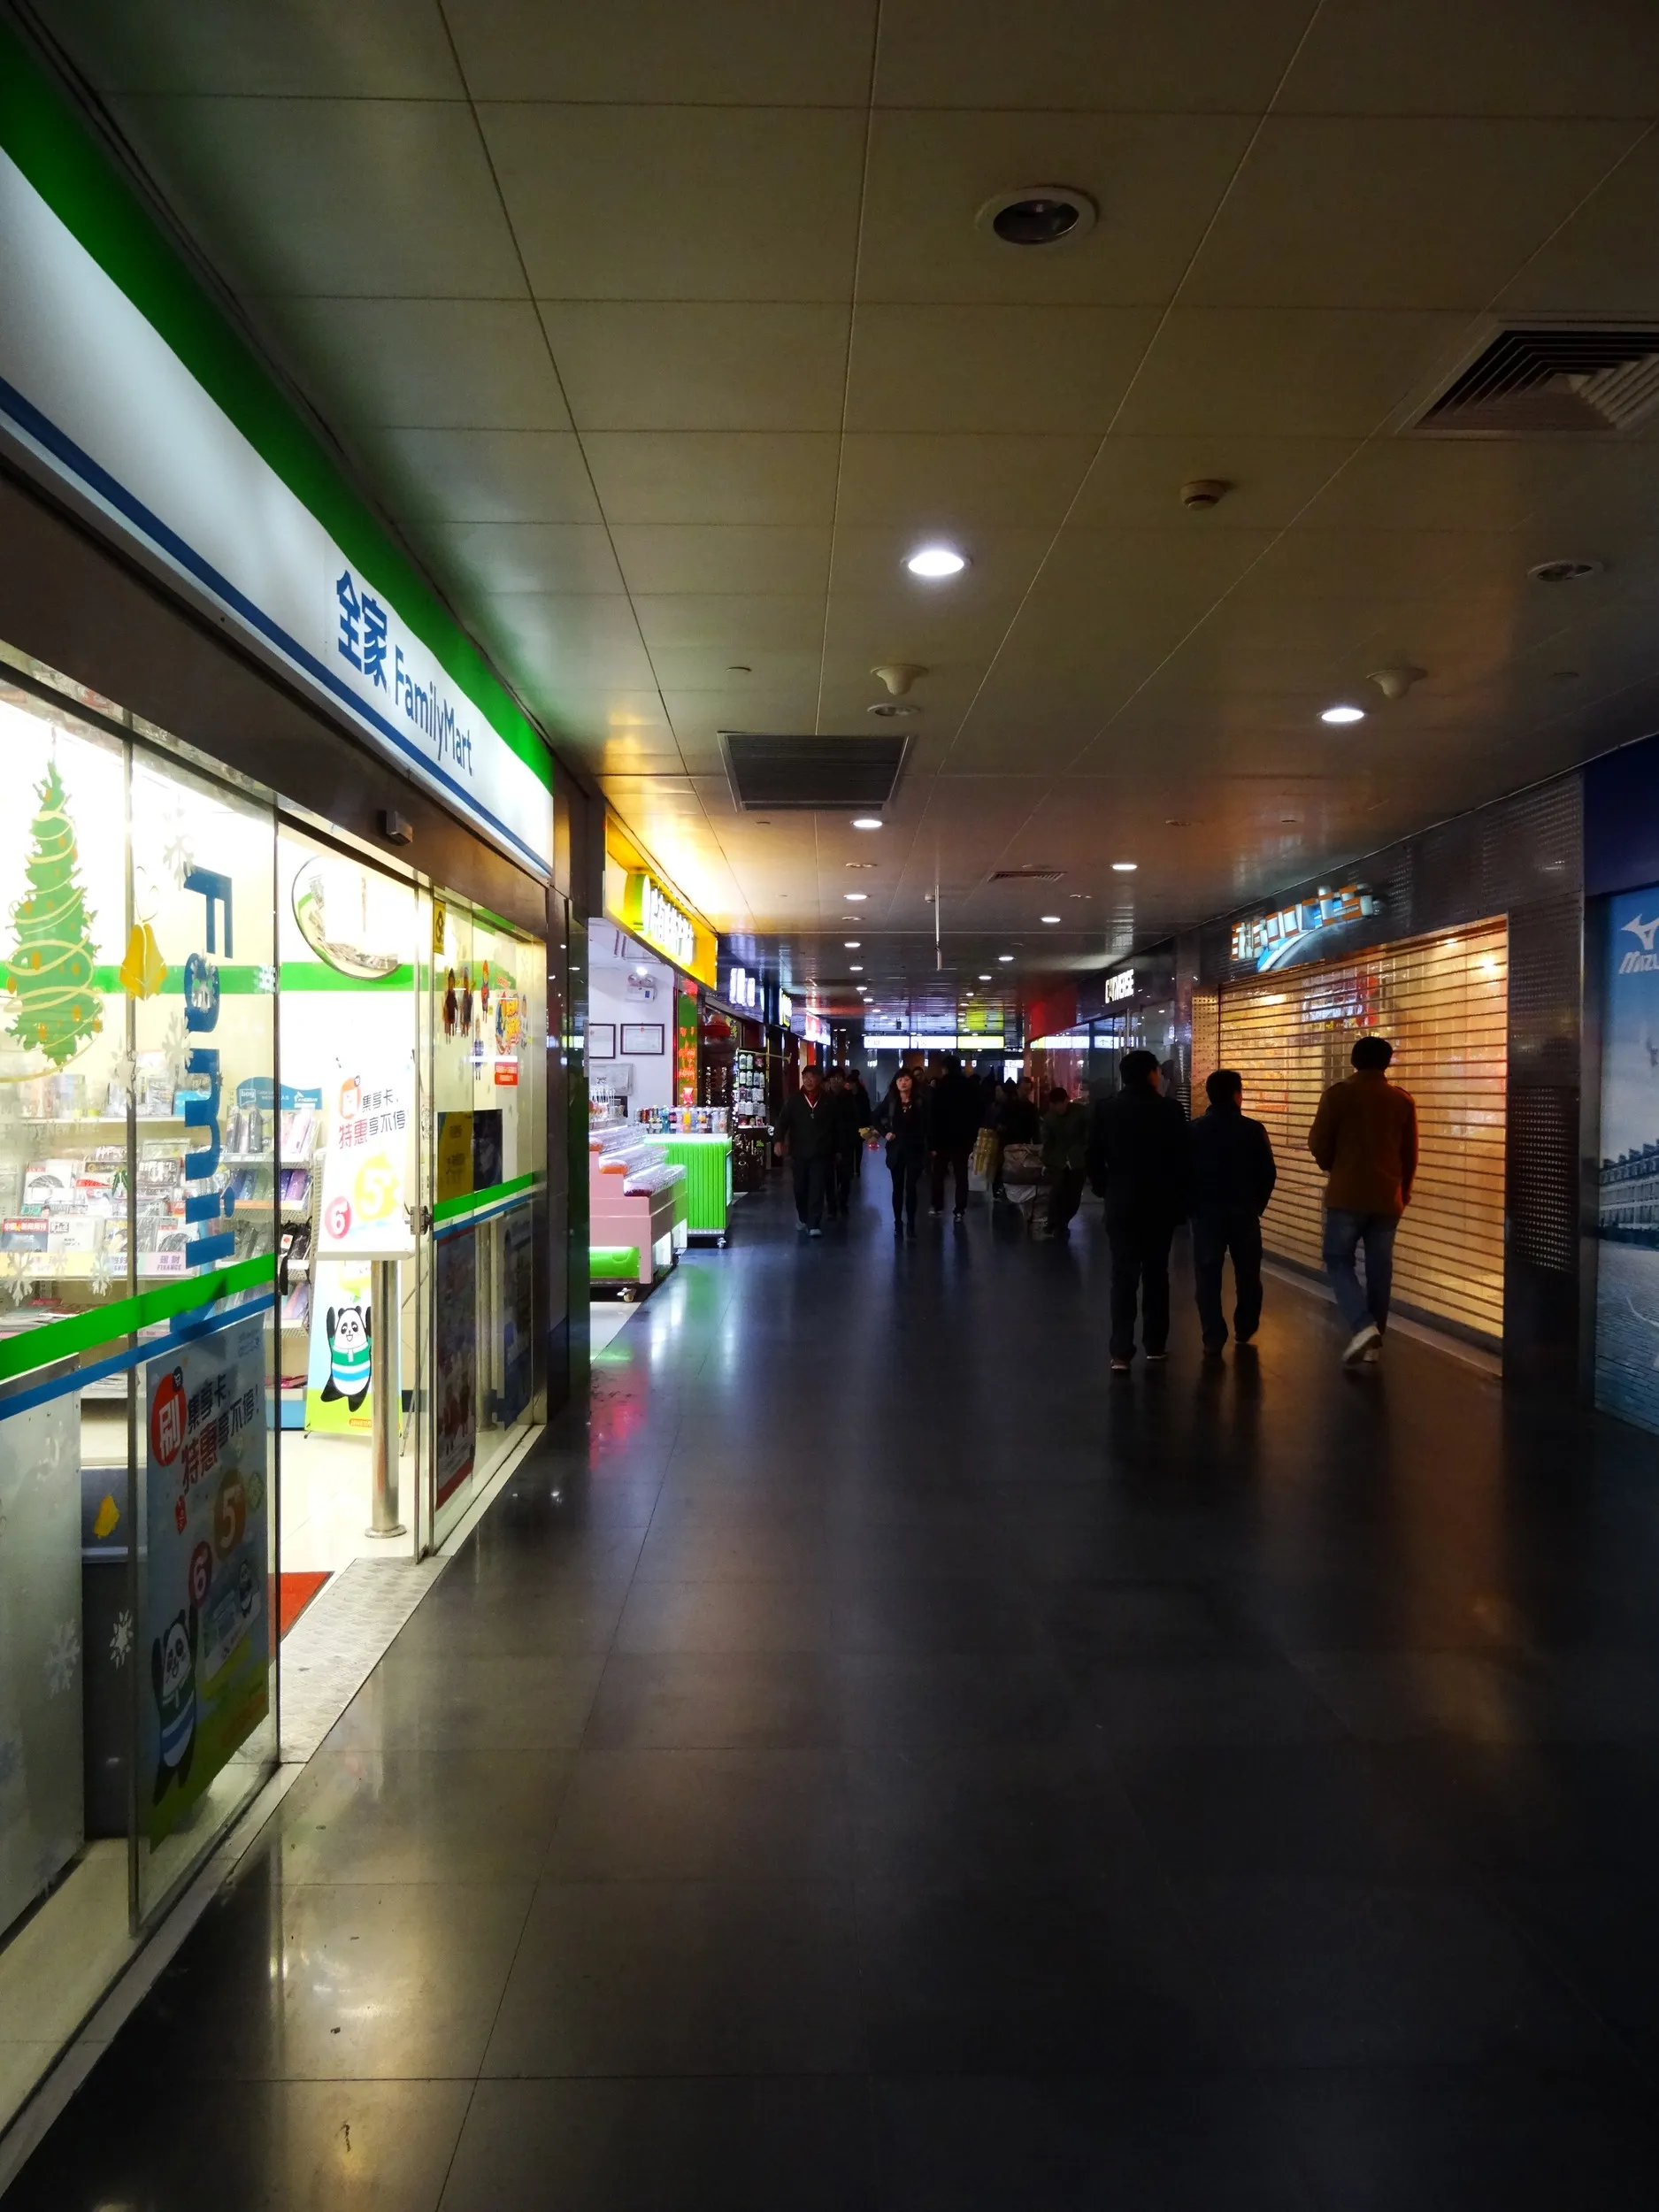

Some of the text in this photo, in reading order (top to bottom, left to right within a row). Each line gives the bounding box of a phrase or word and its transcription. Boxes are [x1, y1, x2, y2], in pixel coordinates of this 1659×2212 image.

[336, 569, 472, 777] 全家 FamilyMart
[330, 1200, 349, 1236] 6
[221, 1484, 242, 1550] 5
[193, 1547, 208, 1601] 6
